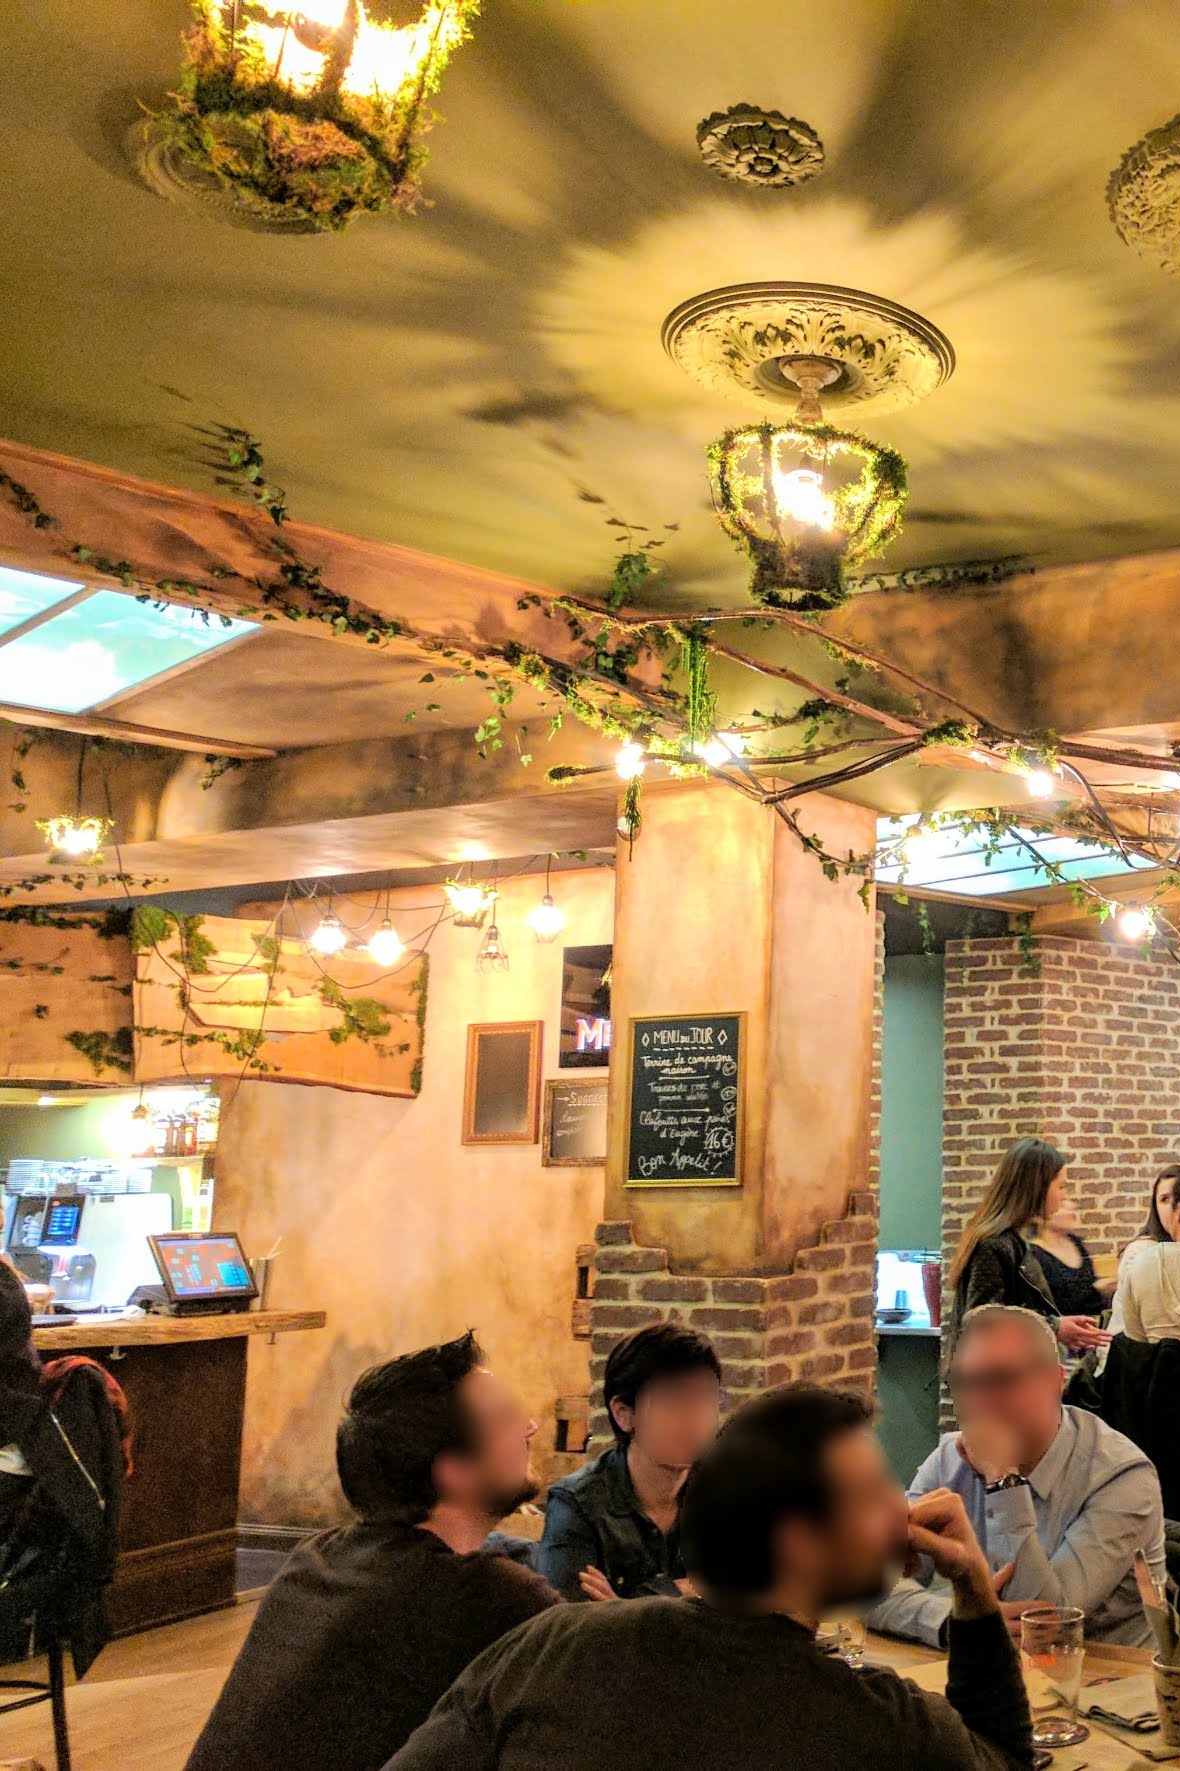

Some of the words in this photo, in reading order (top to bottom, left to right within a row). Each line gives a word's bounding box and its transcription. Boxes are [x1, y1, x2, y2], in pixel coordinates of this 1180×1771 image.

[653, 1029, 680, 1045] MENU
[689, 1026, 714, 1044] JOUR
[641, 1055, 673, 1068] Terrine
[674, 1052, 686, 1064] de
[687, 1053, 734, 1071] campagne
[660, 1065, 697, 1075] maison
[639, 1111, 679, 1131] Clafoutis
[680, 1116, 703, 1124] aux
[638, 1155, 667, 1177] Bon
